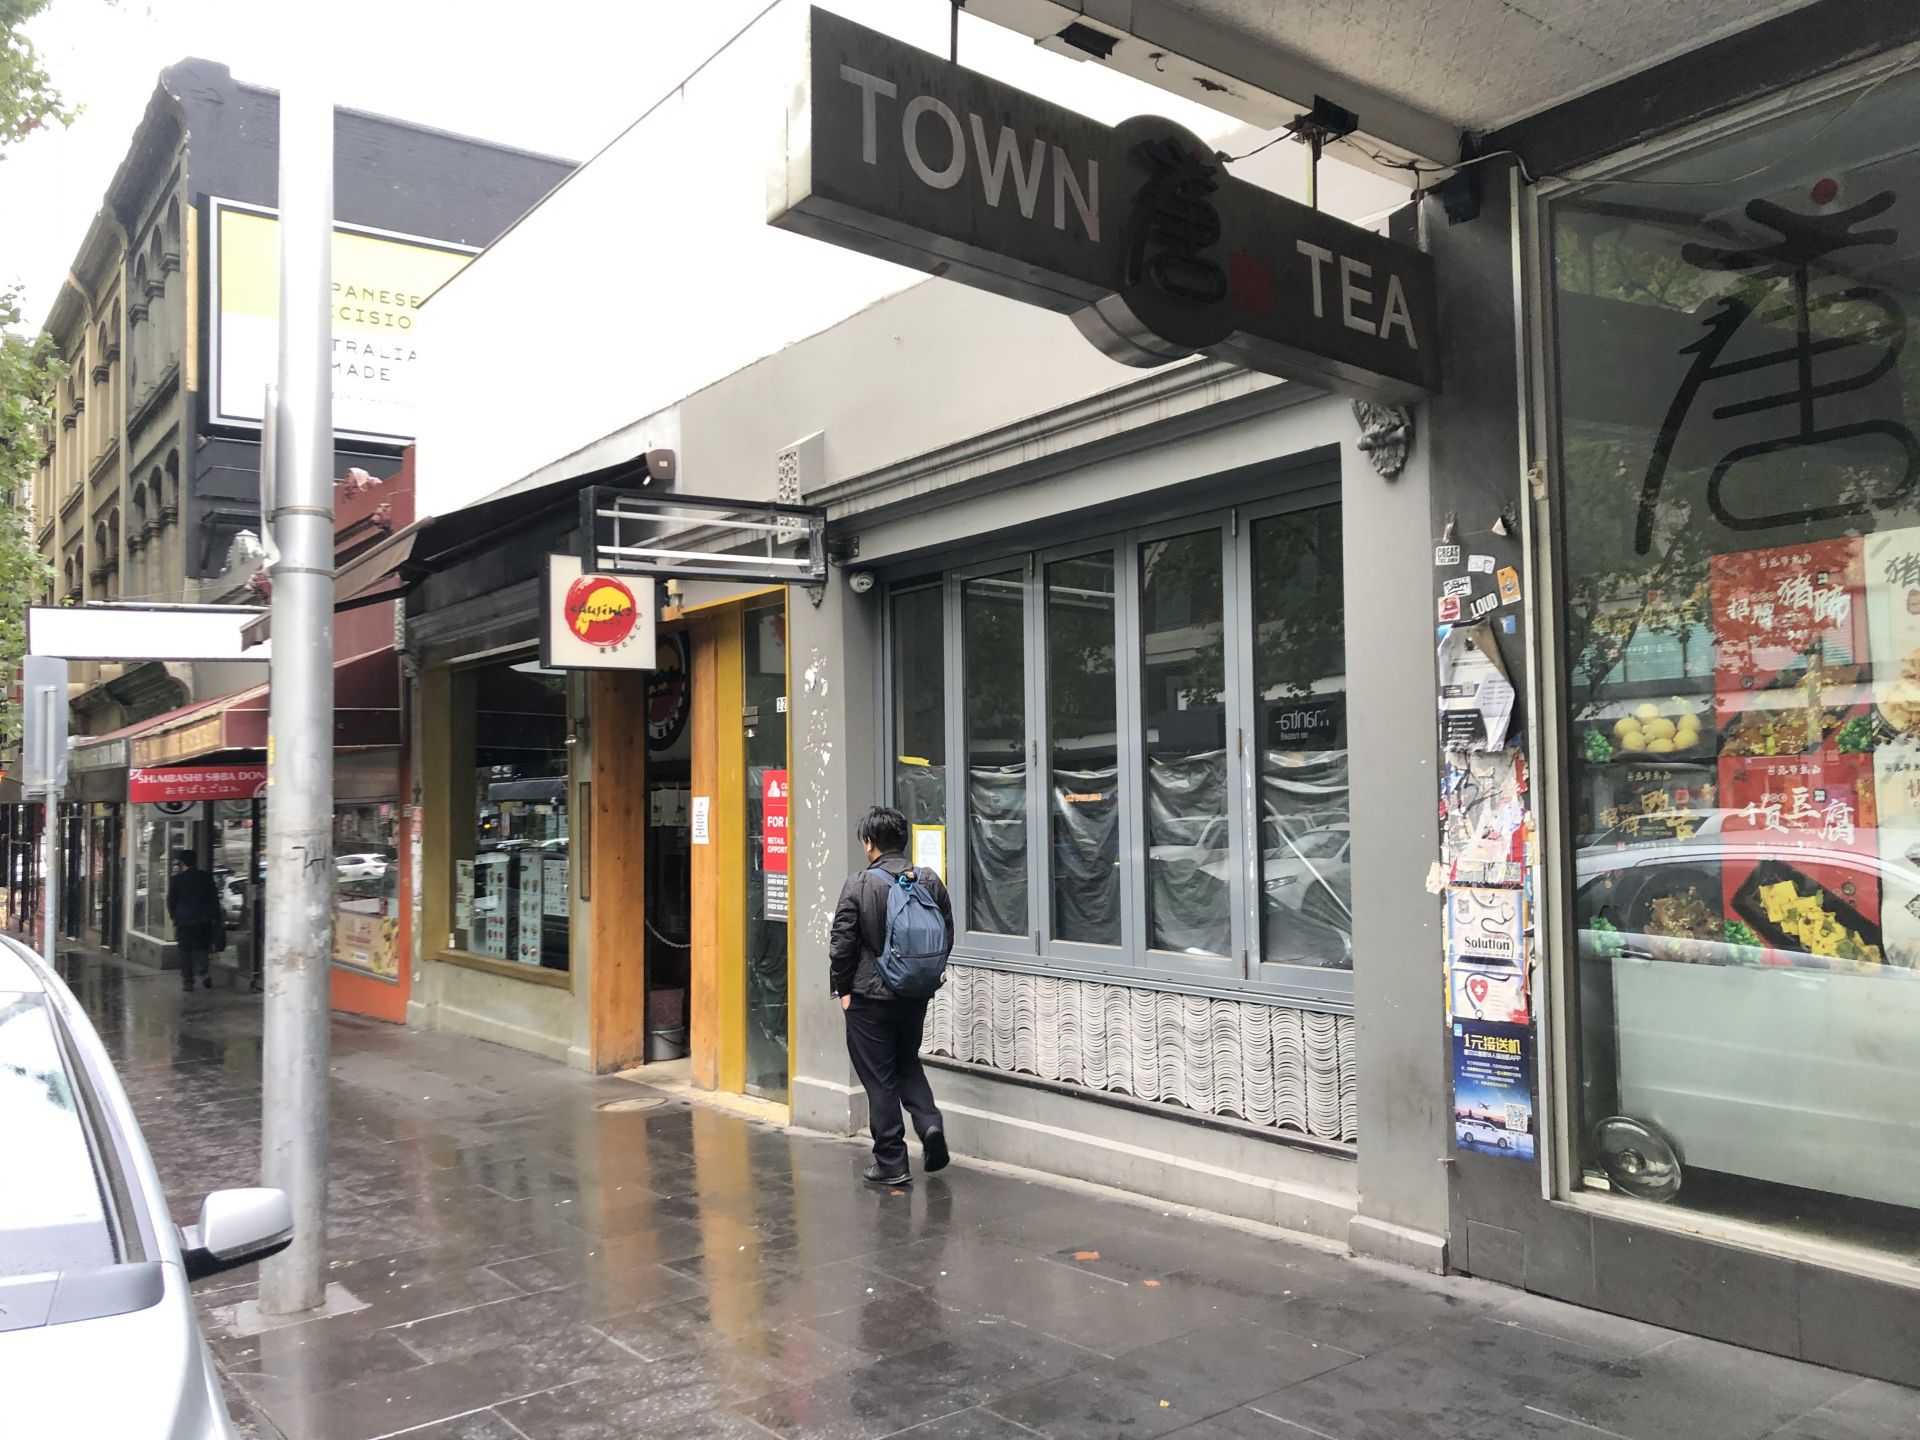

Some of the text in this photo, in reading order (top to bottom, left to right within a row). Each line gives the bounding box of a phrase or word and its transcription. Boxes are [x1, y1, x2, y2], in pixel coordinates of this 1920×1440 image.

[840, 64, 1418, 350] TOWN TEA
[767, 816, 784, 828] FOR
[767, 836, 785, 845] RETAIL
[1464, 936, 1510, 950] Solution
